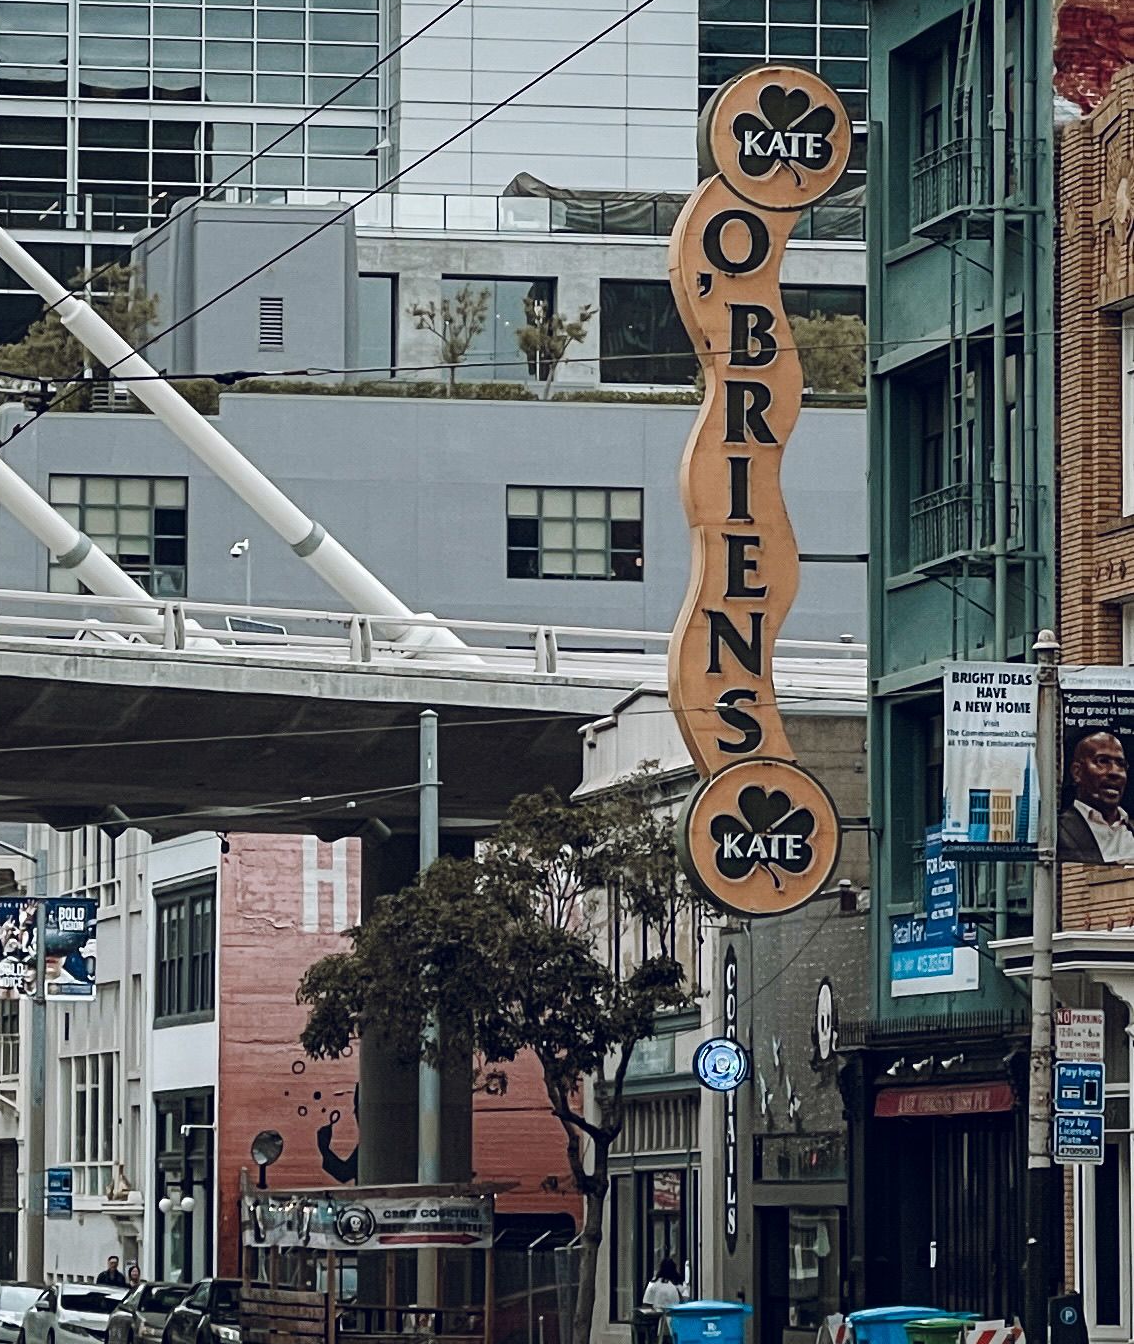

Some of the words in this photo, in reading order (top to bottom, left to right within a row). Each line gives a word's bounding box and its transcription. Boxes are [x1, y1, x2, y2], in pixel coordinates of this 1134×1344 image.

[743, 129, 823, 161] KATE
[952, 672, 994, 684] BRIGHT
[998, 674, 1032, 685] IDEAS
[976, 687, 1007, 698] HAVE
[952, 701, 961, 712] A
[965, 701, 992, 712] NEW
[996, 702, 1031, 713] HOME
[721, 830, 804, 863] KATE
[59, 907, 85, 921] BOLD
[1057, 1011, 1070, 1024] NO
[1072, 1015, 1102, 1024] PARKING
[1060, 1067, 1077, 1079] Pay
[1078, 1067, 1101, 1077] here
[726, 963, 736, 1235] COTAILS
[1058, 1117, 1075, 1127] Pay
[1077, 1117, 1089, 1128] by
[1058, 1127, 1091, 1135] License
[1058, 1136, 1081, 1144] Plate
